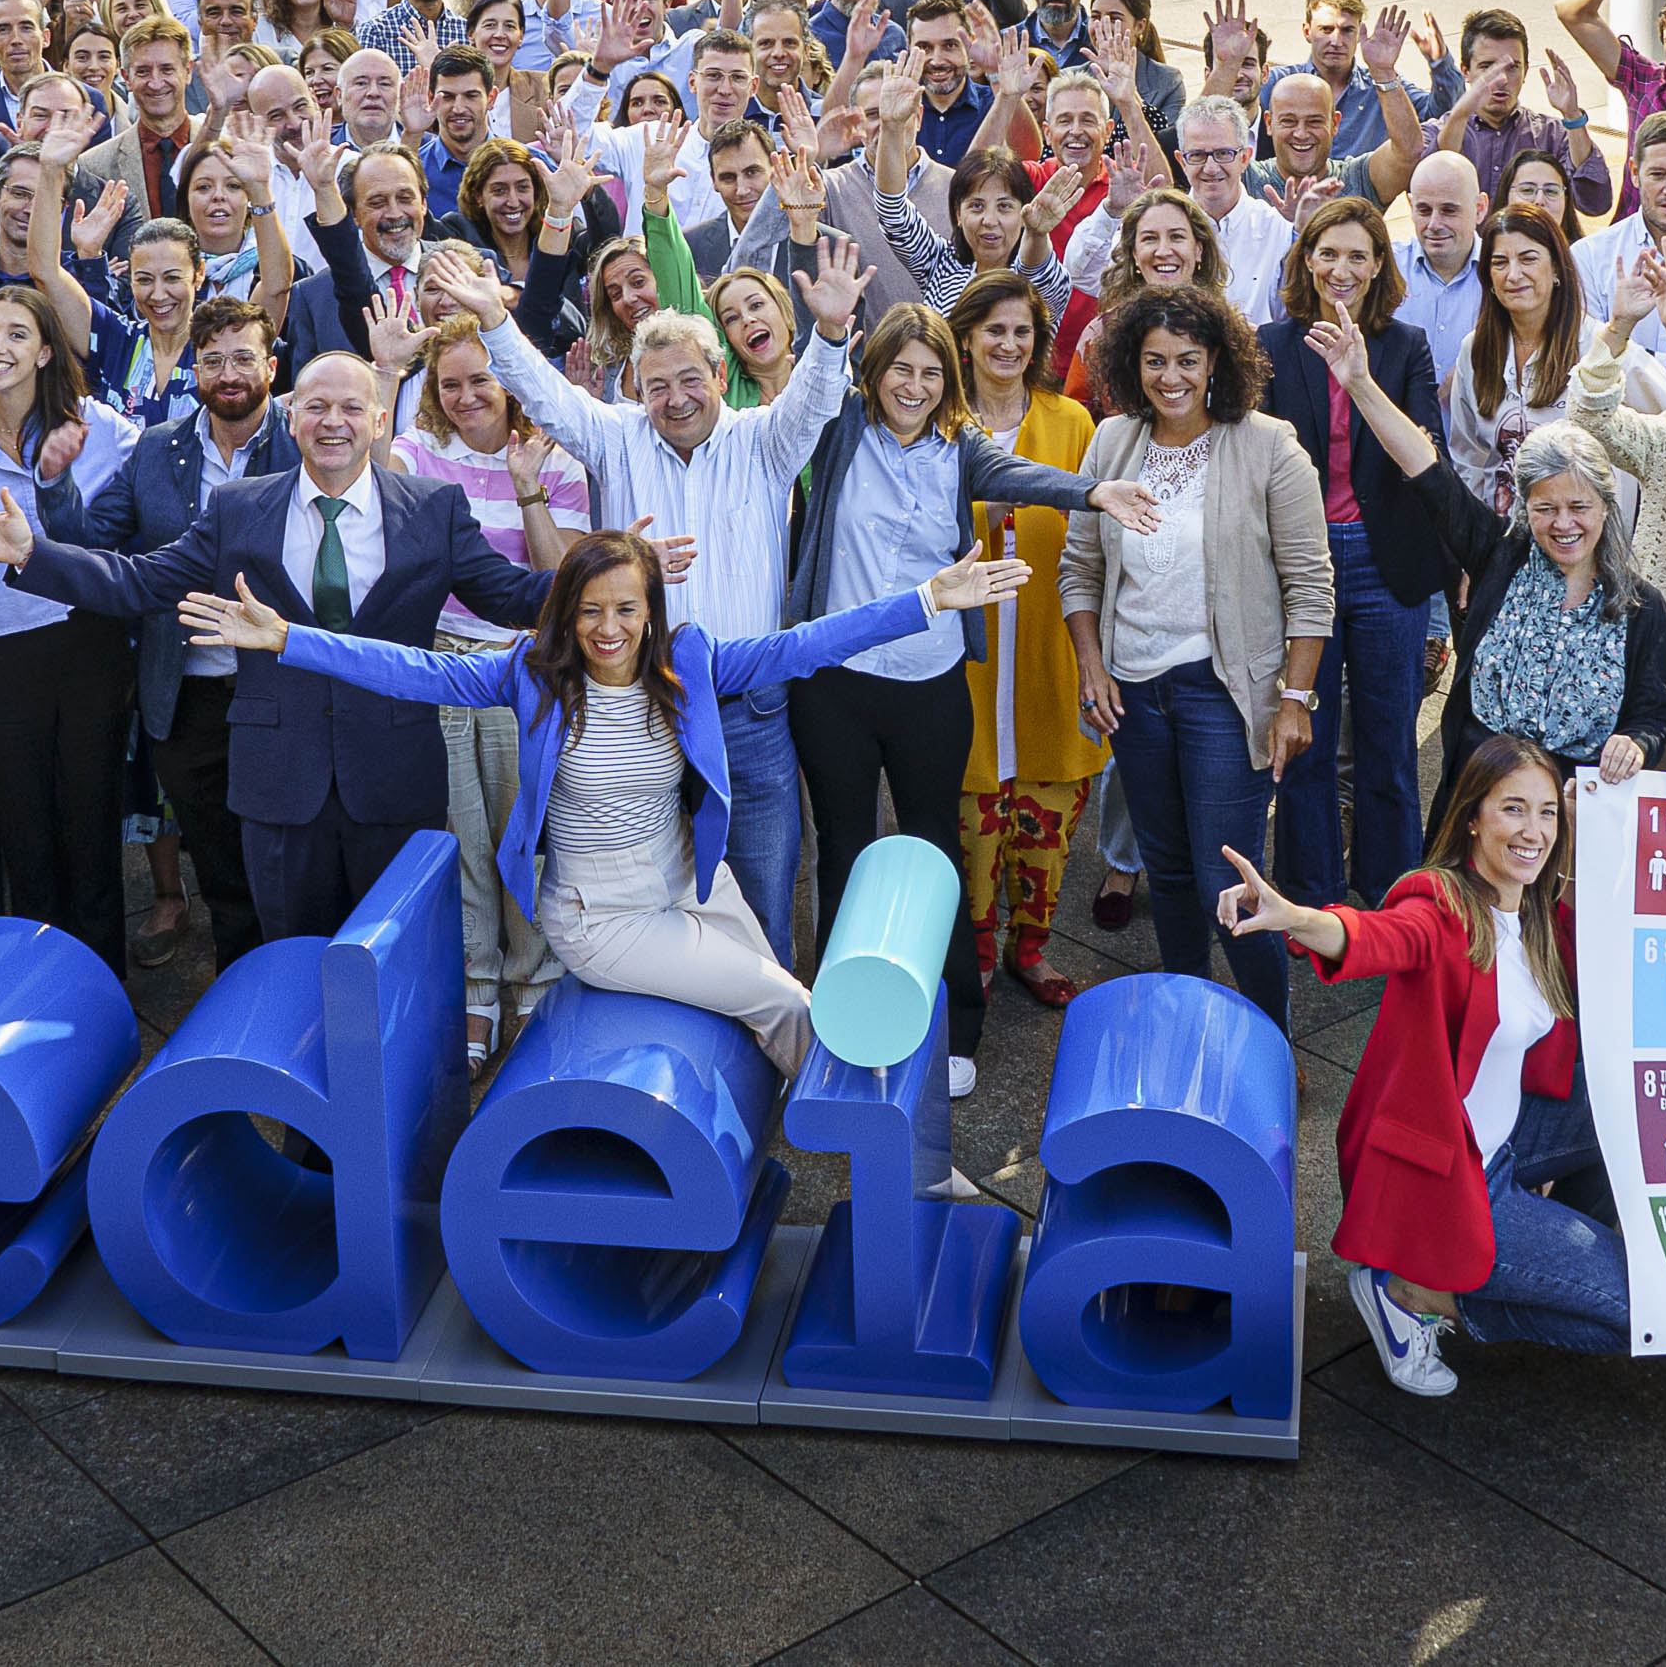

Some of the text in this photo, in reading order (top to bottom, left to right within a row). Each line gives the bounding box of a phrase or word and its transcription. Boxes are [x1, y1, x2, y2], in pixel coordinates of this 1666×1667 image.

[1649, 806, 1659, 833] 1
[1644, 937, 1658, 964] 6
[1644, 1069, 1657, 1097] 8
[1660, 1083, 1666, 1096] Y
